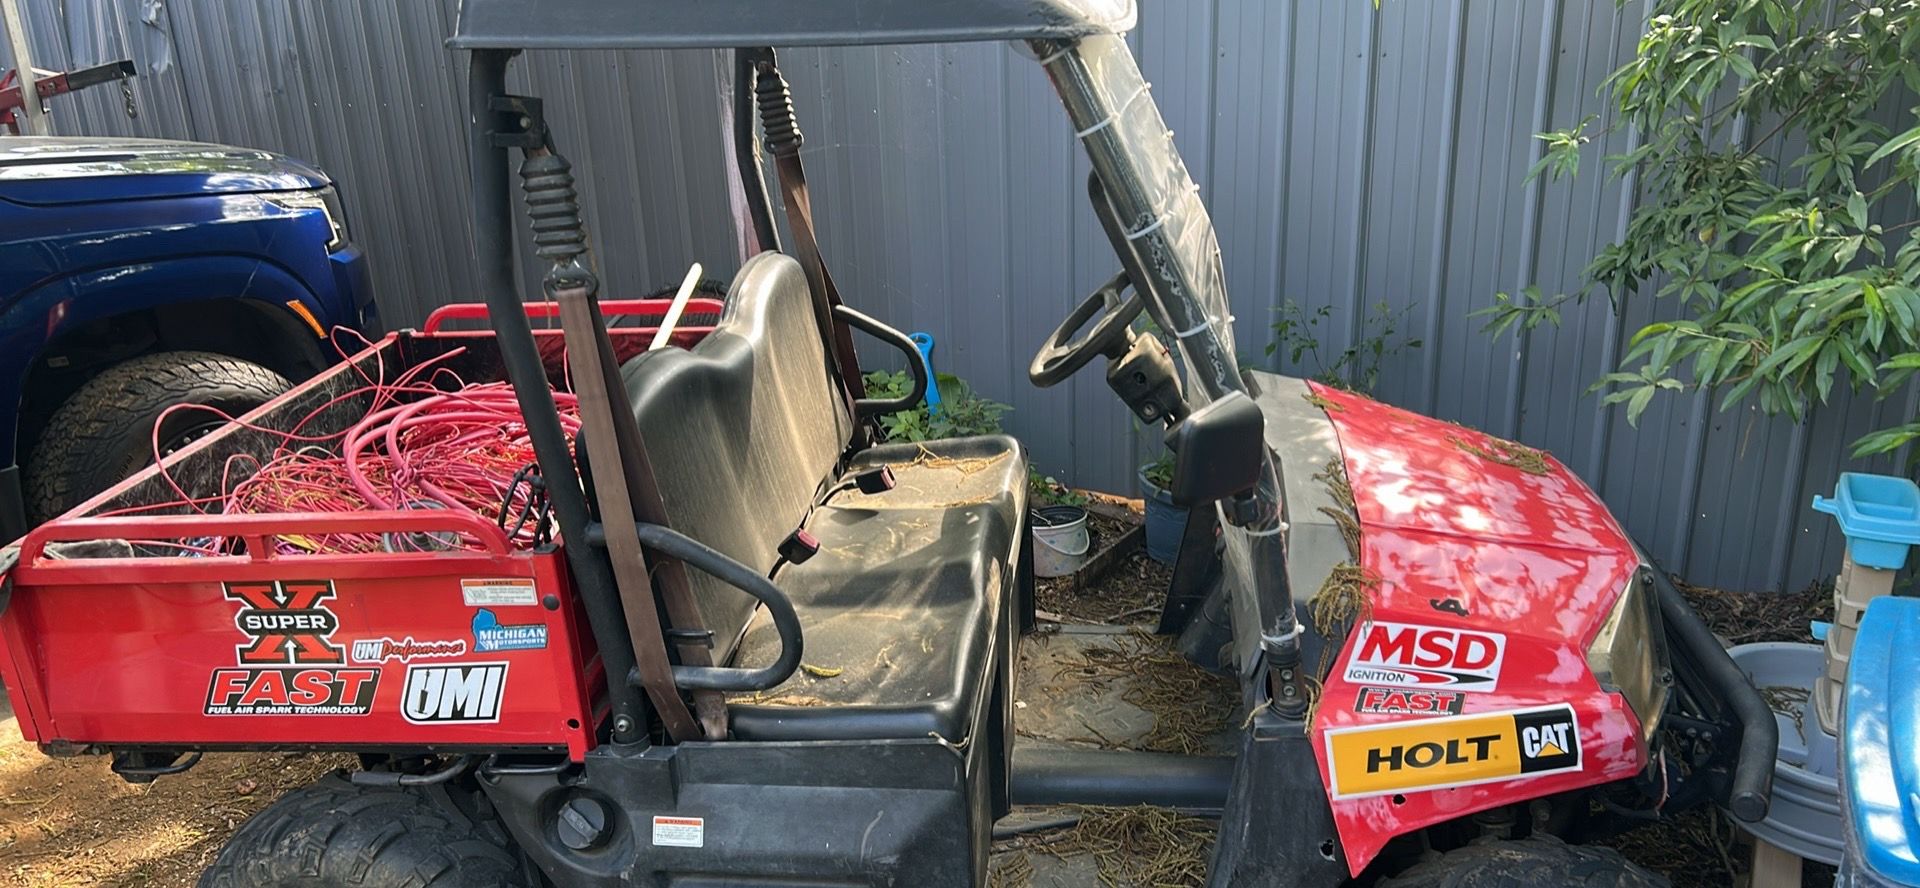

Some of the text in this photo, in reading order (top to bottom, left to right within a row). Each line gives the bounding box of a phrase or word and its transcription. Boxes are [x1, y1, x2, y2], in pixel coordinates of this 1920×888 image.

[246, 615, 328, 630] SUPER
[480, 628, 546, 641] MICHIGAN
[485, 638, 545, 650] MOTORSPORTS
[1357, 626, 1498, 670] MSD
[1348, 669, 1406, 682] IGNITION
[211, 671, 374, 705] FAST
[405, 667, 501, 718] UMI
[208, 706, 366, 714] FUEL AIR SPARK TECHNOLOGY
[1363, 691, 1456, 711] FAST
[1522, 722, 1569, 758] CAT
[1367, 735, 1501, 773] HOLT
